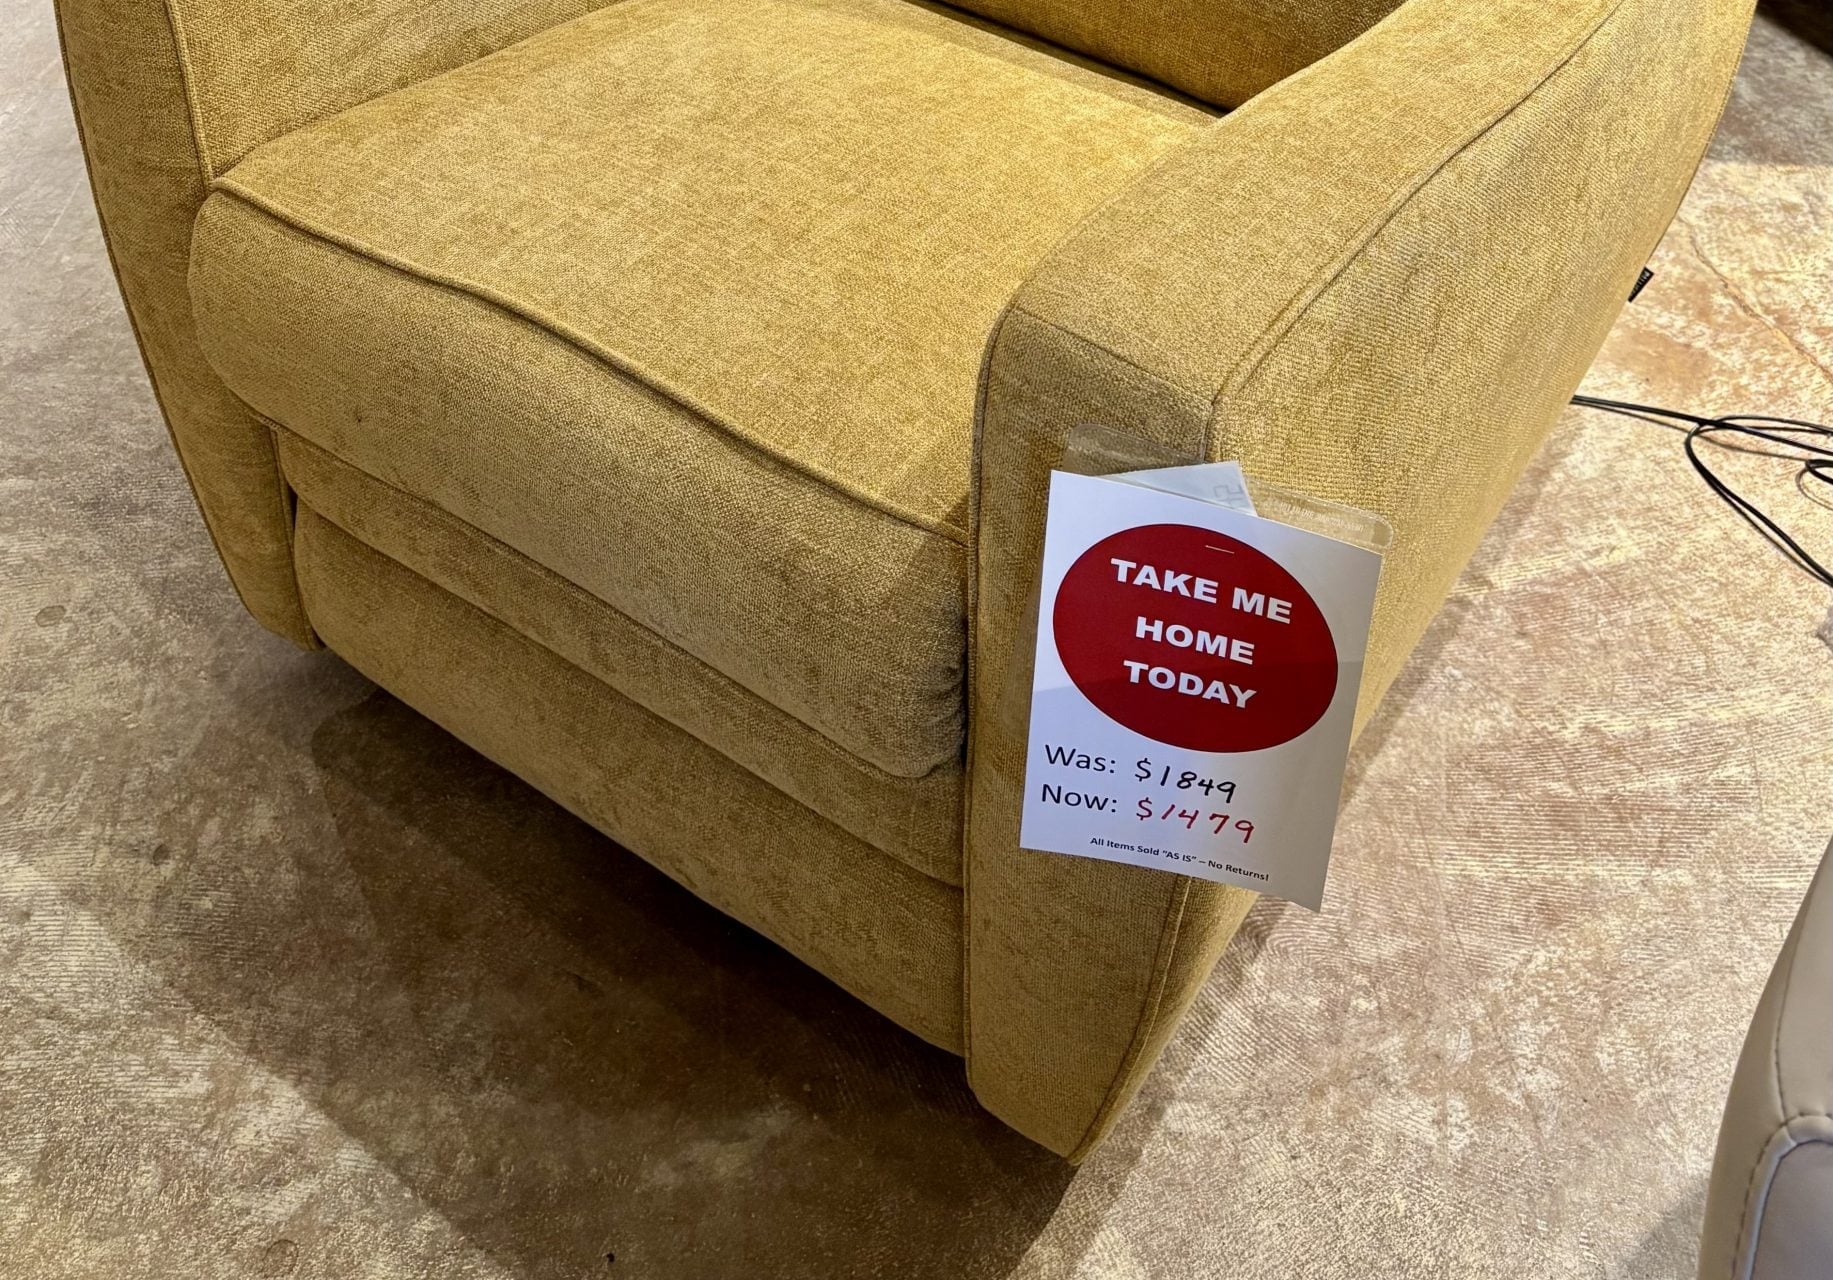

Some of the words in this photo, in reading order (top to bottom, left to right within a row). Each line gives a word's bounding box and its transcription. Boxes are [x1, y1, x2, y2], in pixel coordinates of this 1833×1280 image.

[1110, 557, 1219, 604] TAKE
[1232, 586, 1293, 625] ME
[1135, 615, 1255, 665] HOME
[1123, 659, 1257, 709] TODAY
[1044, 744, 1116, 774] Was:
[1134, 757, 1237, 804] $1849
[1041, 783, 1118, 813] Now:
[1136, 796, 1255, 844] $1479
[1090, 837, 1104, 847] All
[1106, 839, 1135, 852] Items
[1137, 845, 1160, 856] Sold
[1208, 860, 1223, 870] No
[1225, 863, 1269, 882] Returns!
